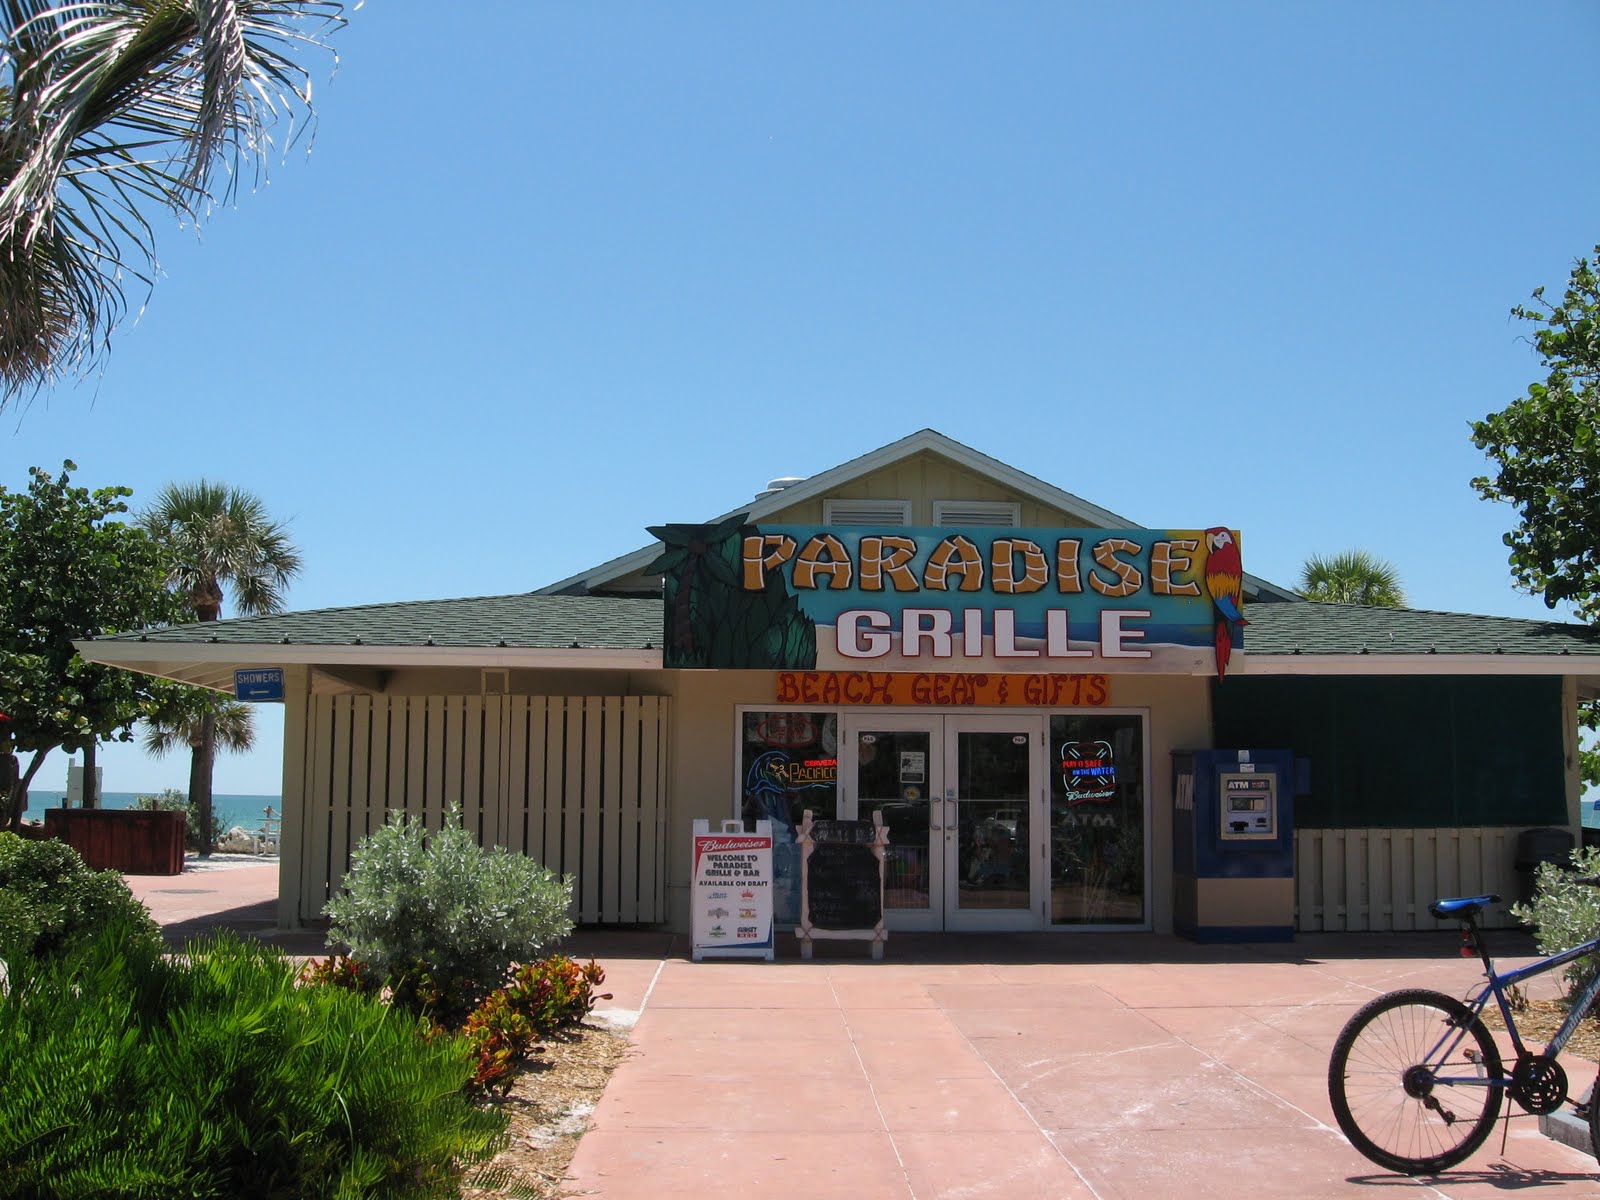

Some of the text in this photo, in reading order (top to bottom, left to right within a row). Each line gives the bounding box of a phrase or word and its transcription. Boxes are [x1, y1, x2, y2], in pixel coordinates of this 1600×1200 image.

[742, 533, 1202, 597] PARADISE
[835, 608, 1153, 660] GRILLE
[237, 672, 280, 684] SHOWERS
[777, 672, 893, 704] BEACH
[1023, 673, 1107, 705] GIFTS
[804, 759, 837, 767] CERVEZA
[1062, 760, 1077, 768] PLAY
[1085, 760, 1103, 768] SAFE
[1081, 768, 1091, 776] THE
[1091, 766, 1115, 776] WATER
[1066, 790, 1116, 801] Budweiser
[1063, 813, 1116, 827] ATM
[697, 839, 766, 852] Budweiser
[707, 854, 758, 862] WELCOME TO
[705, 869, 732, 877] GRILLE
[743, 869, 760, 877] BAR
